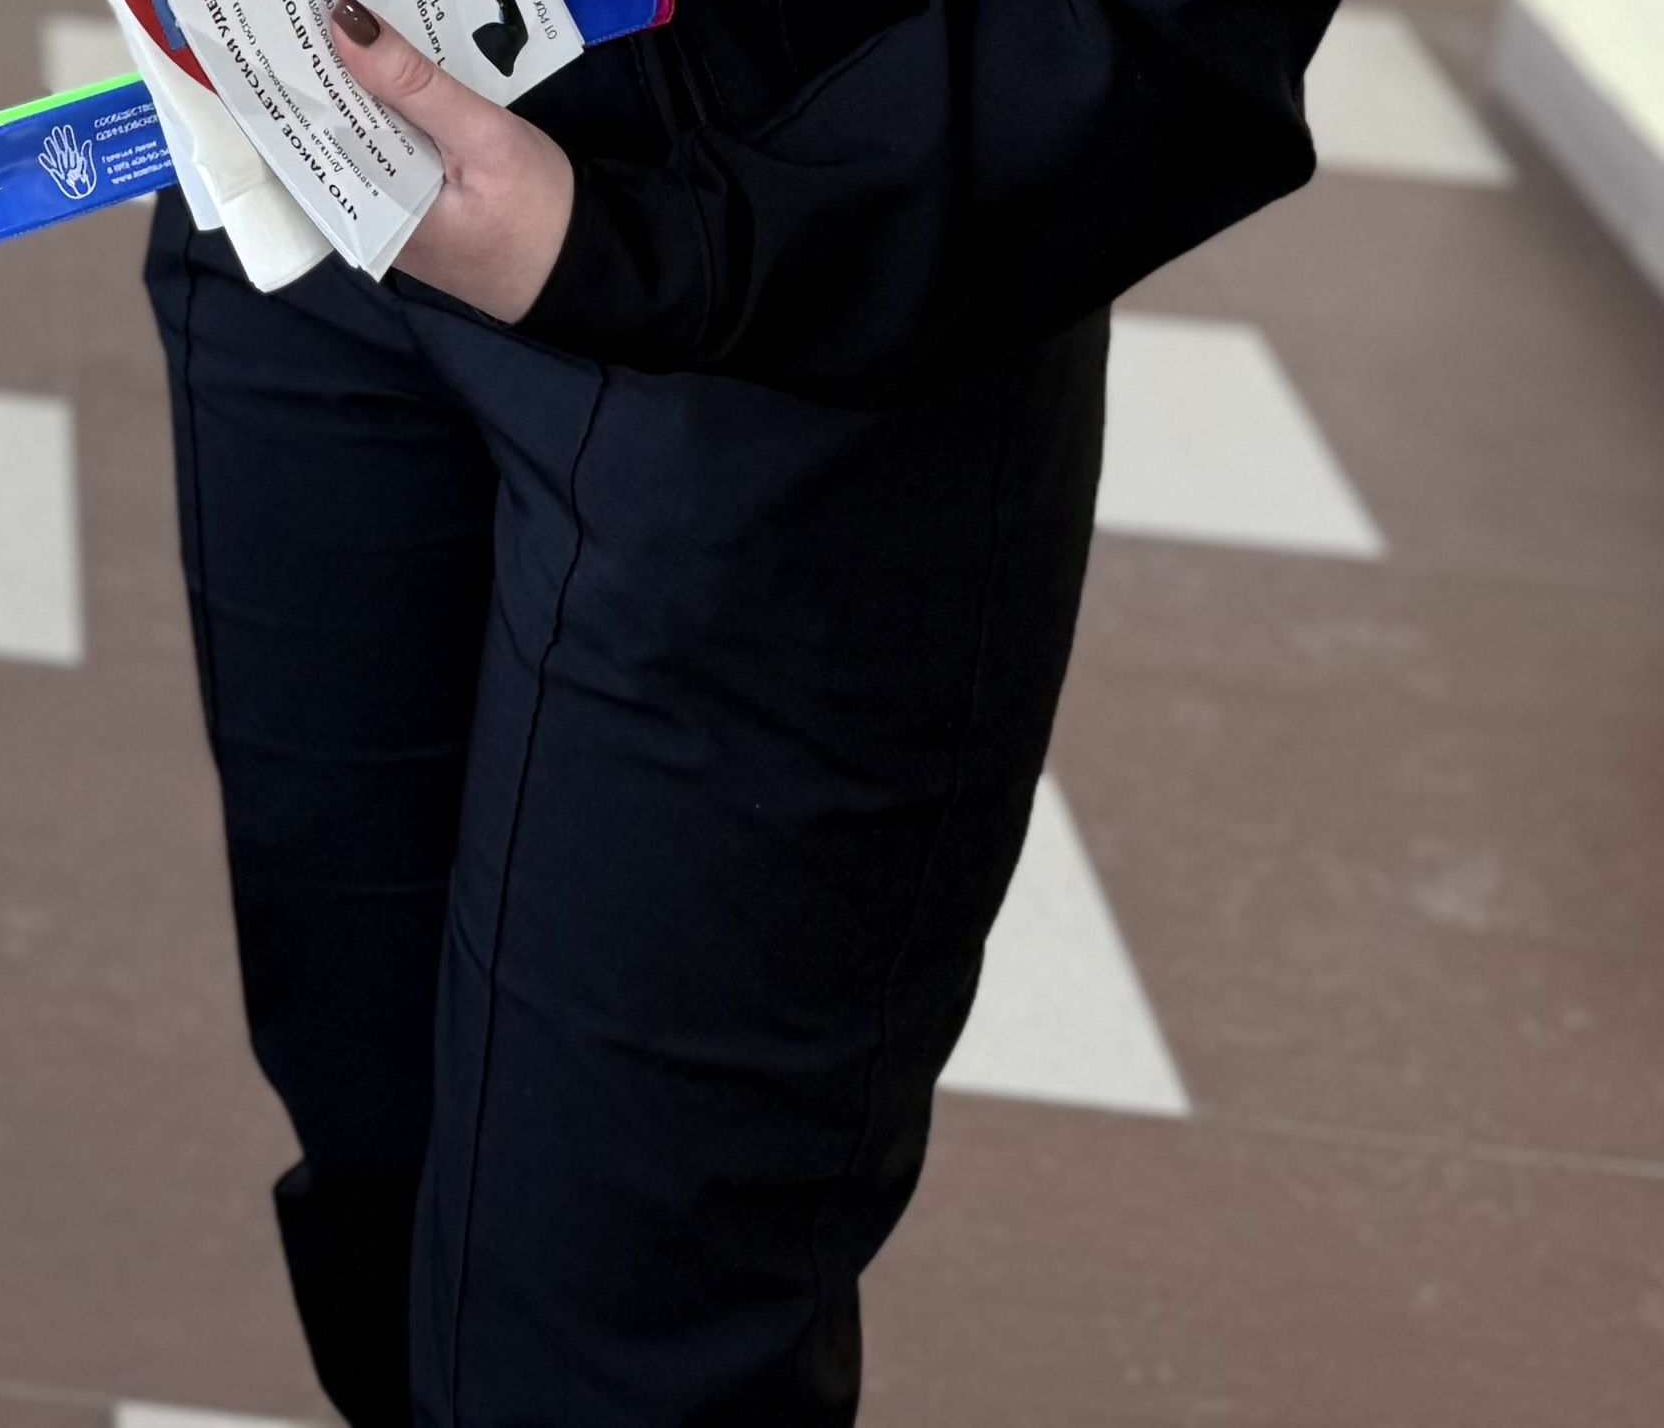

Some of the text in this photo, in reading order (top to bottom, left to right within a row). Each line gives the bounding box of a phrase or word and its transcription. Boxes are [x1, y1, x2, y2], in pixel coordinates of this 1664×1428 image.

[226, 37, 286, 122] ДЕТСКАЯ
[311, 53, 367, 140] ВЫБРАТЬ
[281, 123, 327, 184] ТАКОЕ
[365, 138, 397, 178] КАК
[328, 183, 358, 221] ЧТО
